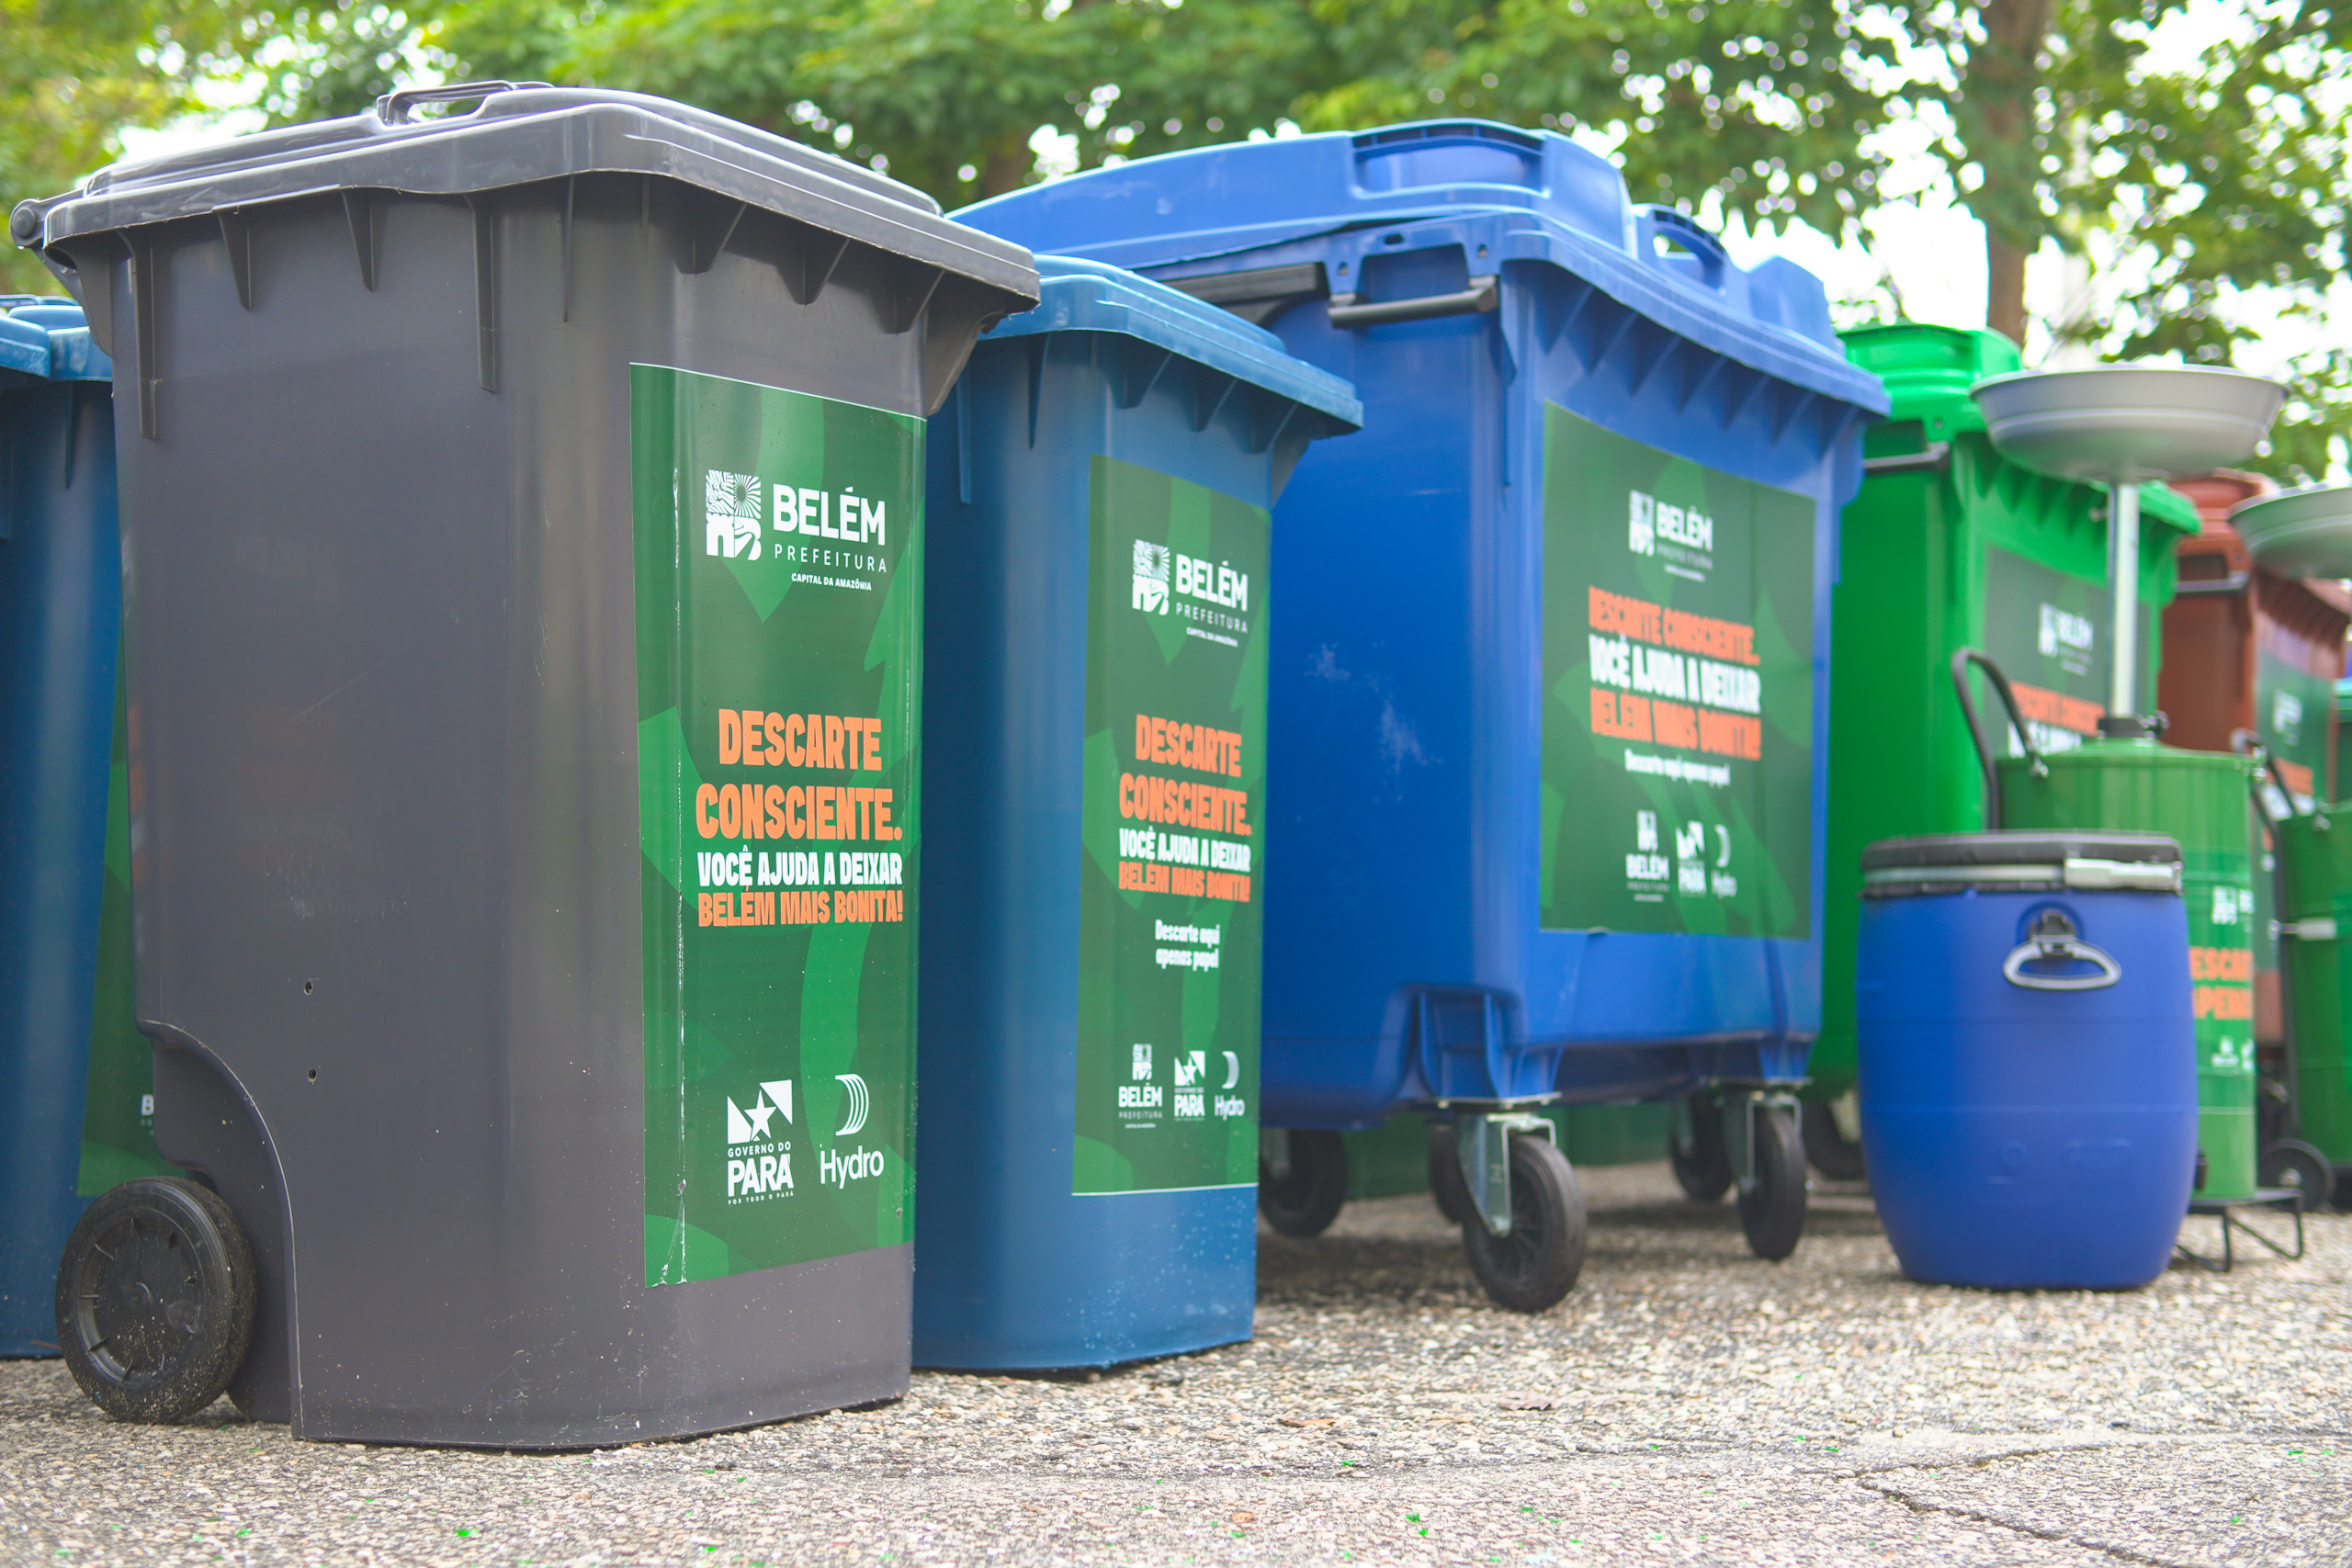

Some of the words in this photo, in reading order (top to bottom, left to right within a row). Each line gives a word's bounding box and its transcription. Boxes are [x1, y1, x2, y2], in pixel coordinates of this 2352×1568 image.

[774, 486, 886, 546] BELÉM
[1657, 501, 1713, 552] BELÉM
[775, 544, 888, 573] PREFEITURA
[792, 573, 821, 584] CAPITAL
[823, 577, 834, 586] DA
[835, 579, 871, 591] AMAZÔNIA
[1176, 553, 1249, 613] BELÉM
[1176, 603, 1248, 634] PREFEITURA
[1589, 633, 1632, 689] VOCÊ
[1632, 644, 1687, 700] AJUDA
[1687, 656, 1700, 704] A
[1700, 660, 1761, 715] DEIXAR
[718, 709, 882, 771] DESCARTE
[1136, 714, 1242, 778] DESCARTE
[695, 783, 903, 840] CONSCIENTE.
[1119, 773, 1252, 836] CONSCIENTE.
[696, 844, 753, 887] VOCÊ
[757, 852, 820, 886] AJUDA
[823, 852, 836, 886] A
[840, 852, 903, 886] DEIXAR
[1119, 825, 1156, 861] VOCÊ
[1158, 832, 1199, 865] AJUDA
[1200, 838, 1209, 867] A
[1211, 840, 1251, 873] DEIXAR
[1119, 860, 1170, 894] BELÉM
[1171, 866, 1205, 897] MAIS
[1206, 871, 1250, 903] BONITA!
[698, 886, 775, 928] BELÉM
[781, 890, 831, 925] MAIS
[834, 889, 904, 923] BONITA!
[1155, 919, 1199, 943] Descarte
[1200, 924, 1220, 949] aqui
[1156, 948, 1193, 970] apenas
[1193, 948, 1219, 972] papel
[1118, 1082, 1163, 1108] BELÉM
[1215, 1095, 1246, 1121] Hydro
[728, 1143, 775, 1157] GOVERNO
[777, 1141, 791, 1152] DO
[820, 1145, 885, 1190] Hydro
[746, 1195, 764, 1203] TODO
